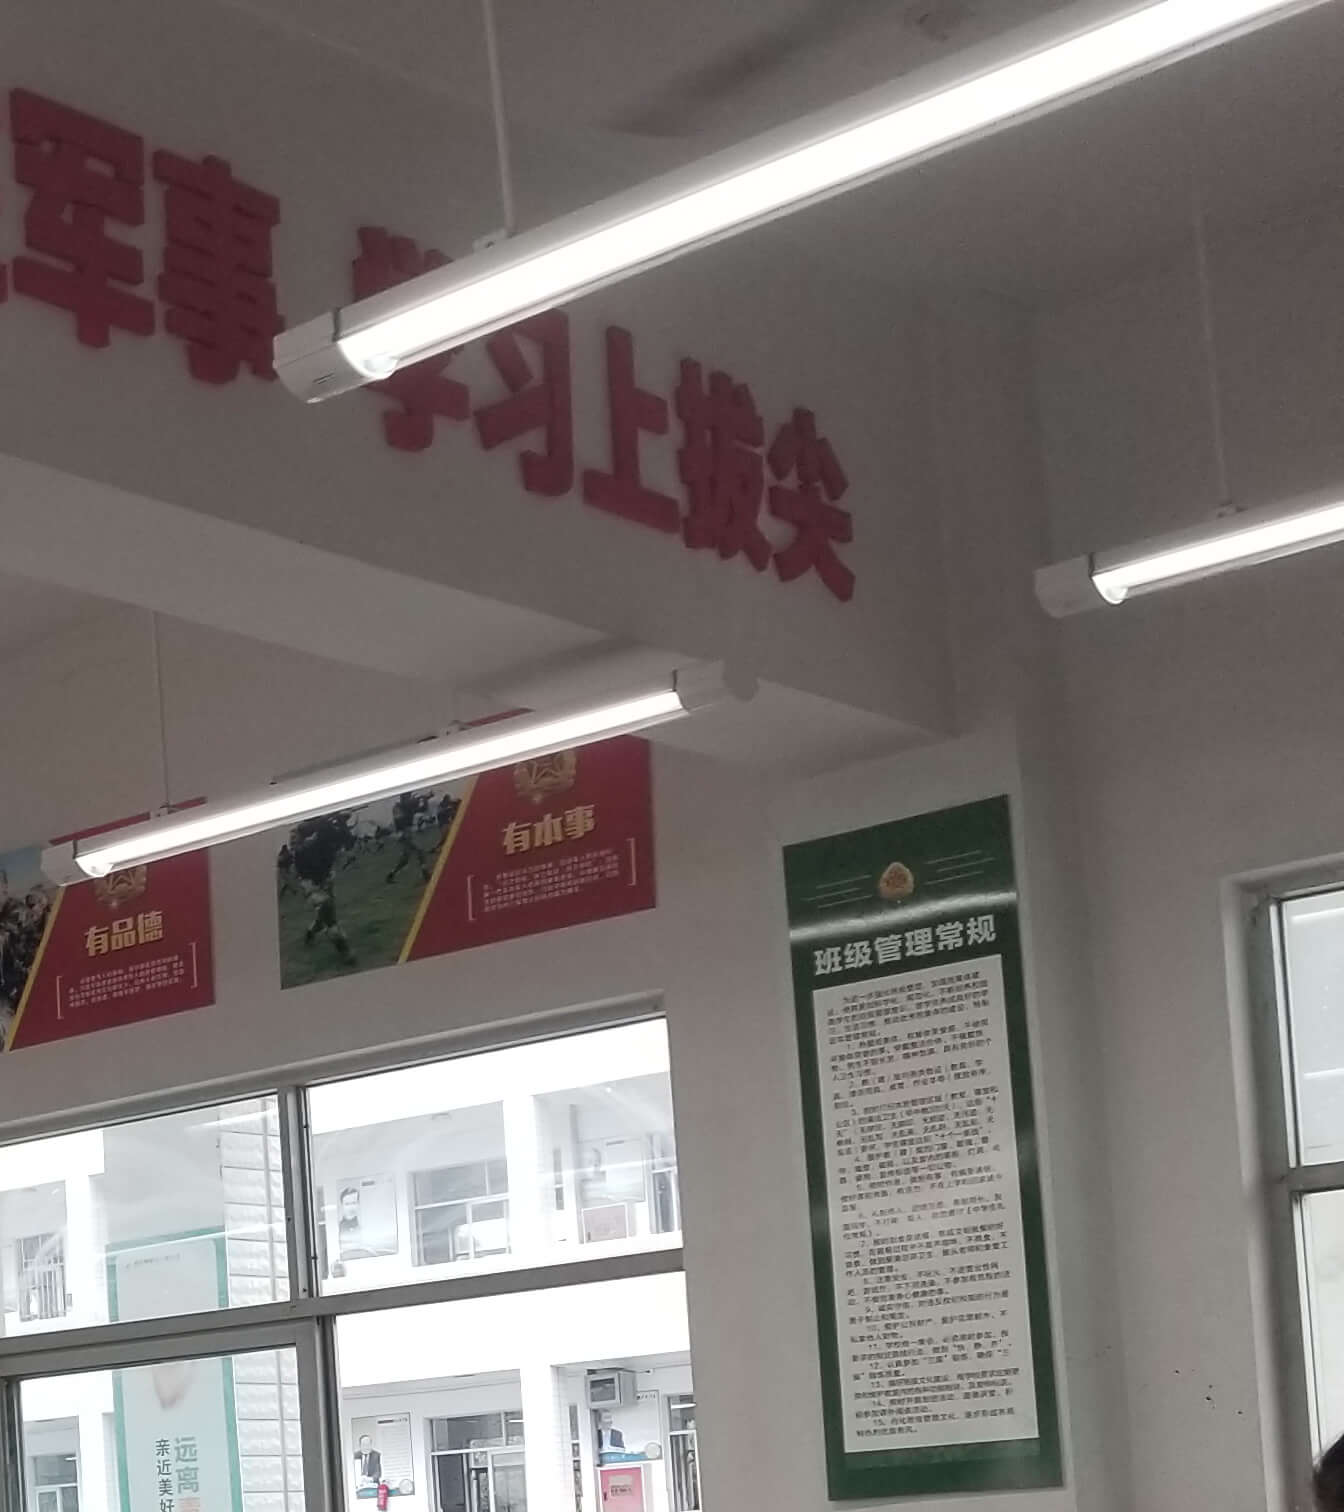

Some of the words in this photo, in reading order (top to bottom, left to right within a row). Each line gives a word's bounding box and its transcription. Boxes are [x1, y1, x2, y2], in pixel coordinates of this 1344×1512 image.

[502, 804, 595, 856] 有本事
[84, 910, 164, 957] 有品德
[814, 914, 997, 976] 班级管理常规
